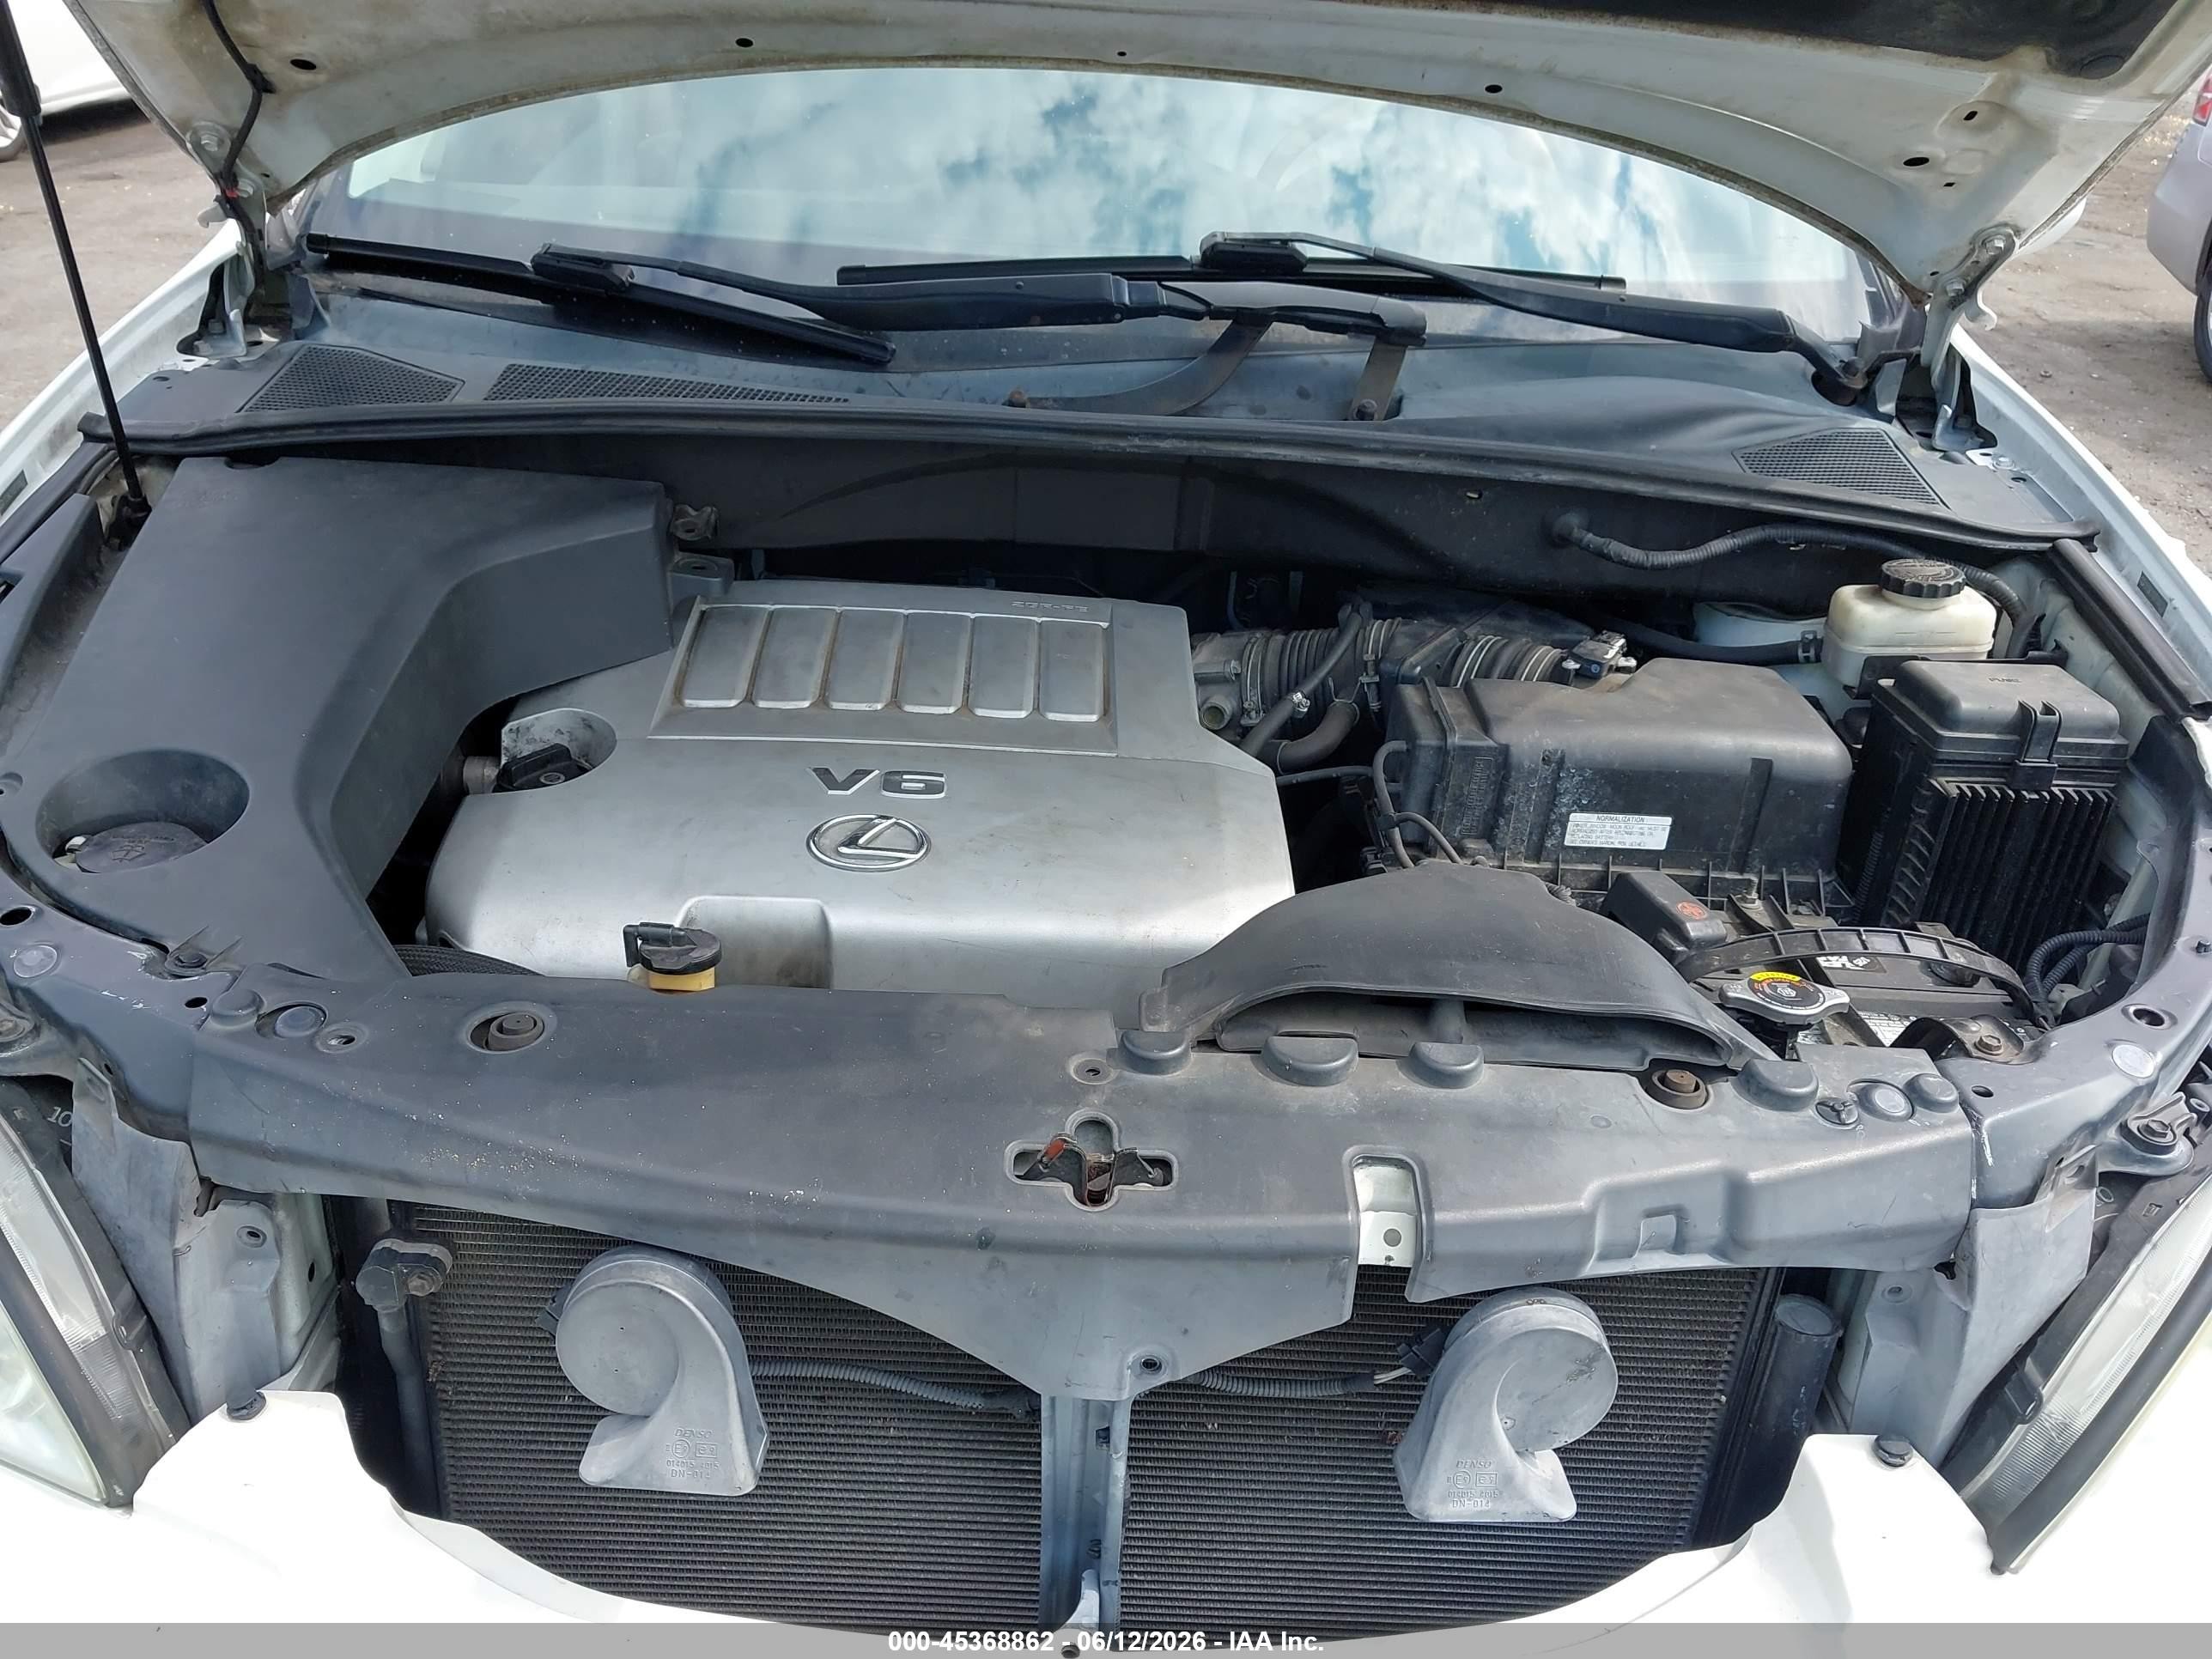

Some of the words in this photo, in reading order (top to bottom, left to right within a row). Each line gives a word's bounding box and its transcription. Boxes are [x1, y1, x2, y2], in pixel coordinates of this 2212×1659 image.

[805, 767, 947, 799] V6
[674, 1427, 714, 1437] DENSO
[1455, 1460, 1492, 1469] DENSO
